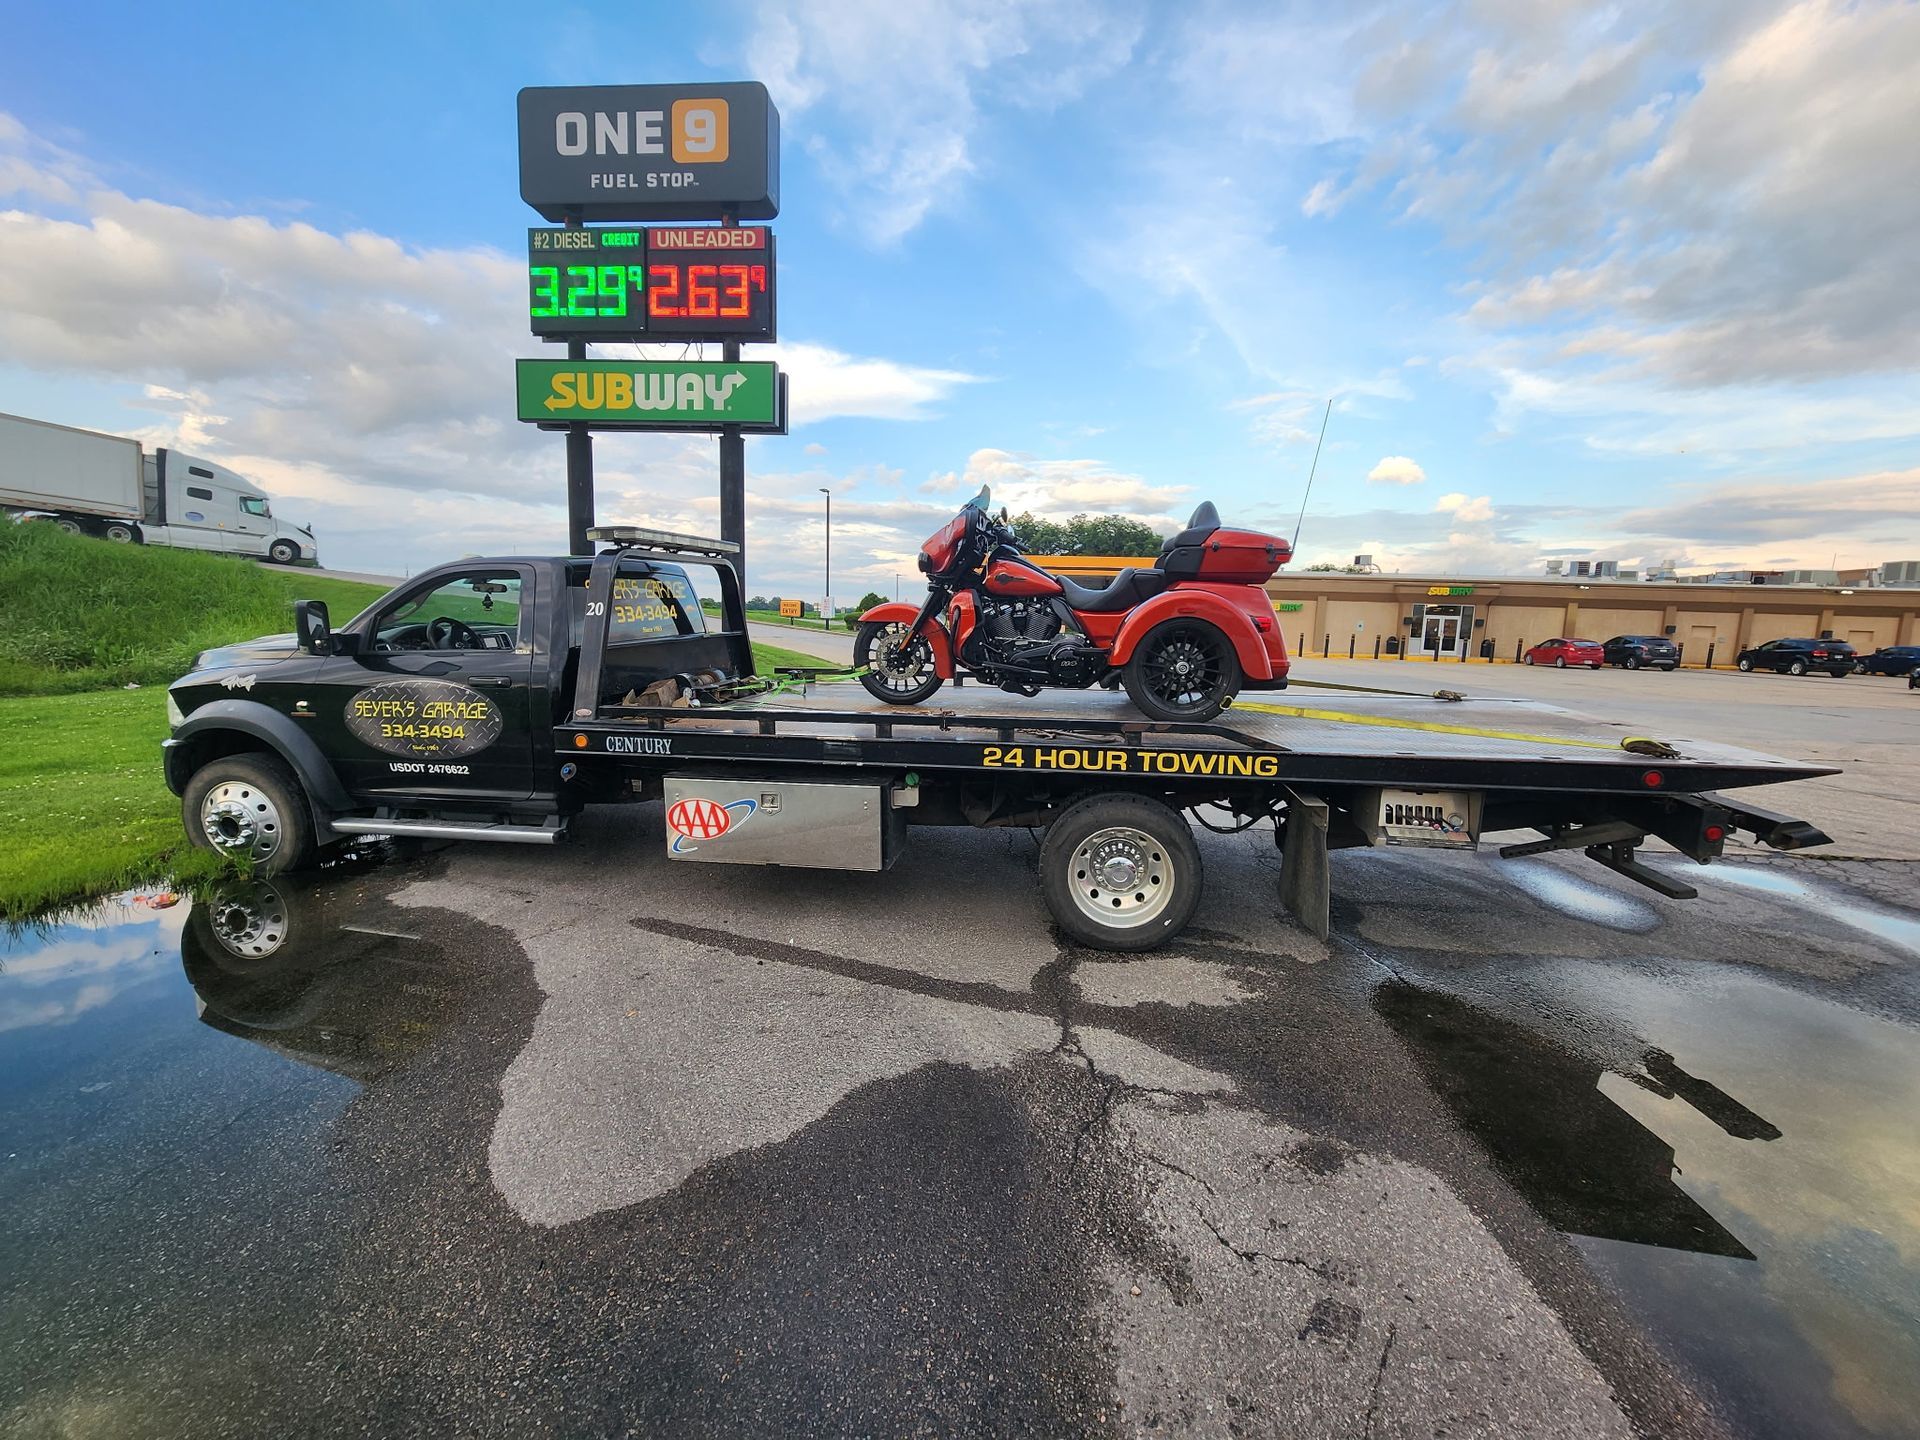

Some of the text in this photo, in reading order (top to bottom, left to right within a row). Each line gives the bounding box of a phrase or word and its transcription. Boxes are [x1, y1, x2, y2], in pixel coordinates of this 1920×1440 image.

[555, 109, 716, 156] ONE 9
[591, 172, 695, 188] FUEL STOP
[533, 232, 640, 249] #2 DIESEL CREDIT
[656, 231, 756, 247] UNLEADED
[544, 371, 747, 411] SUBWAY
[1427, 587, 1473, 596] SUBWAY
[586, 602, 604, 616] 20
[614, 605, 678, 624] 334-3494
[1273, 602, 1303, 611] BWAY
[354, 700, 488, 719] SEYER'S GARAGE
[381, 724, 465, 739] 334-3494
[606, 736, 672, 754] CENTURY
[389, 762, 470, 775] USDOT 2476622
[983, 747, 1279, 776] 24 HOUR TOWING
[673, 800, 725, 838] AAA
